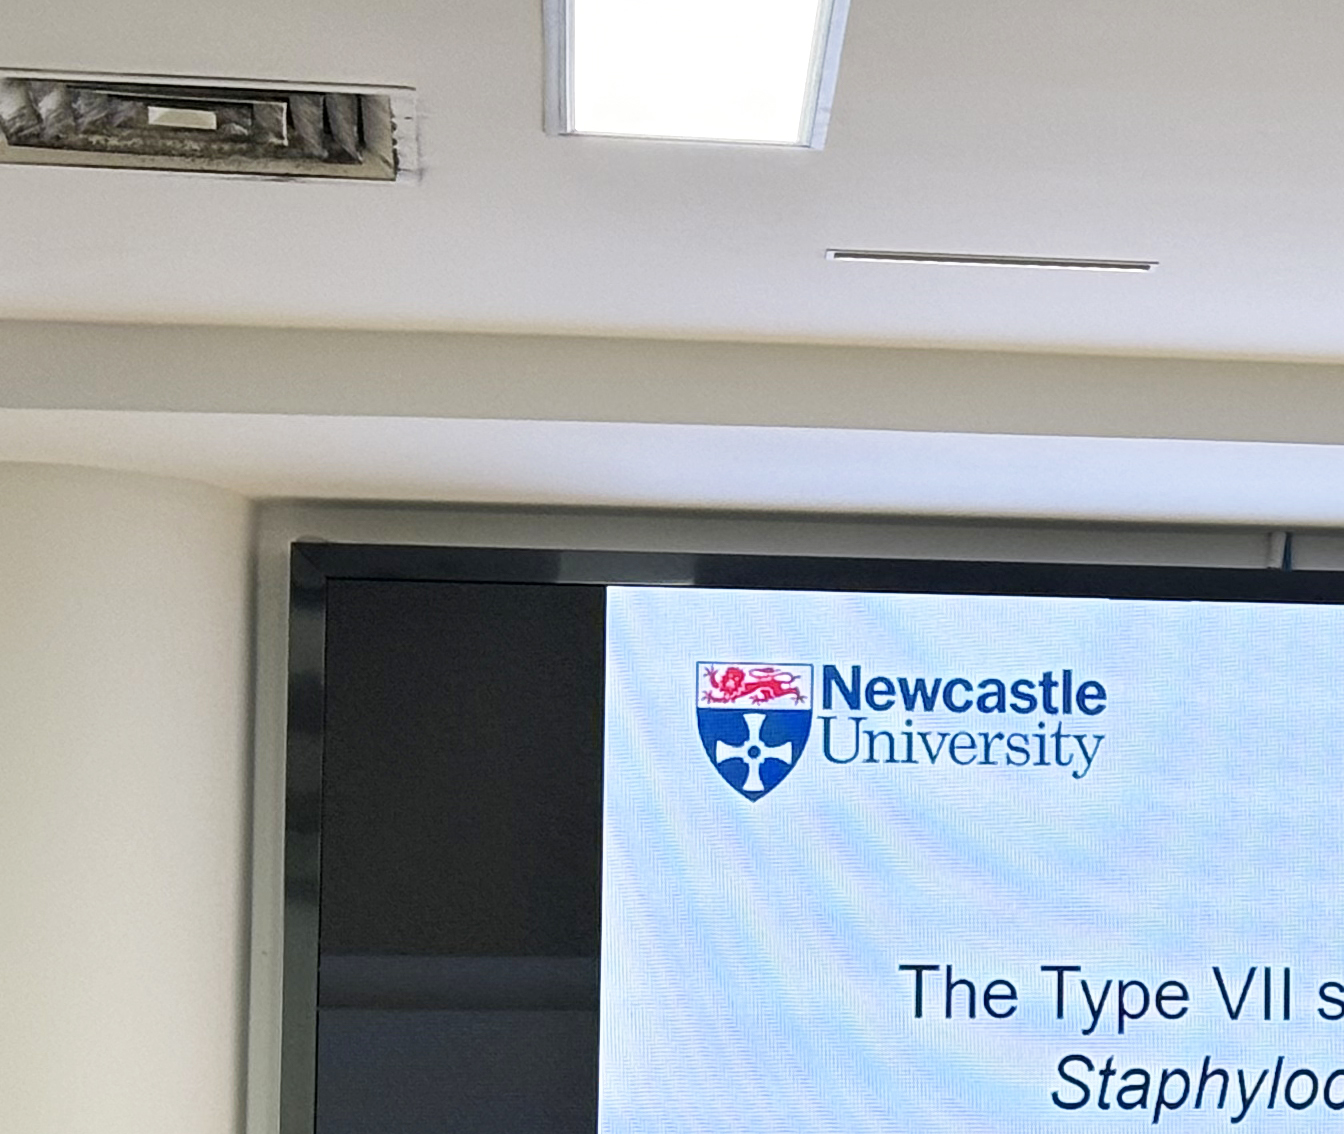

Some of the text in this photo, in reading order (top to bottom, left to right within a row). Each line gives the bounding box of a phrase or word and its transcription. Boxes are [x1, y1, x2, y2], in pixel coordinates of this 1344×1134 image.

[822, 664, 1107, 716] Newcastle
[818, 716, 1105, 779] University
[898, 964, 1018, 1019] The
[1041, 965, 1190, 1035] Type
[1212, 966, 1291, 1021] VII
